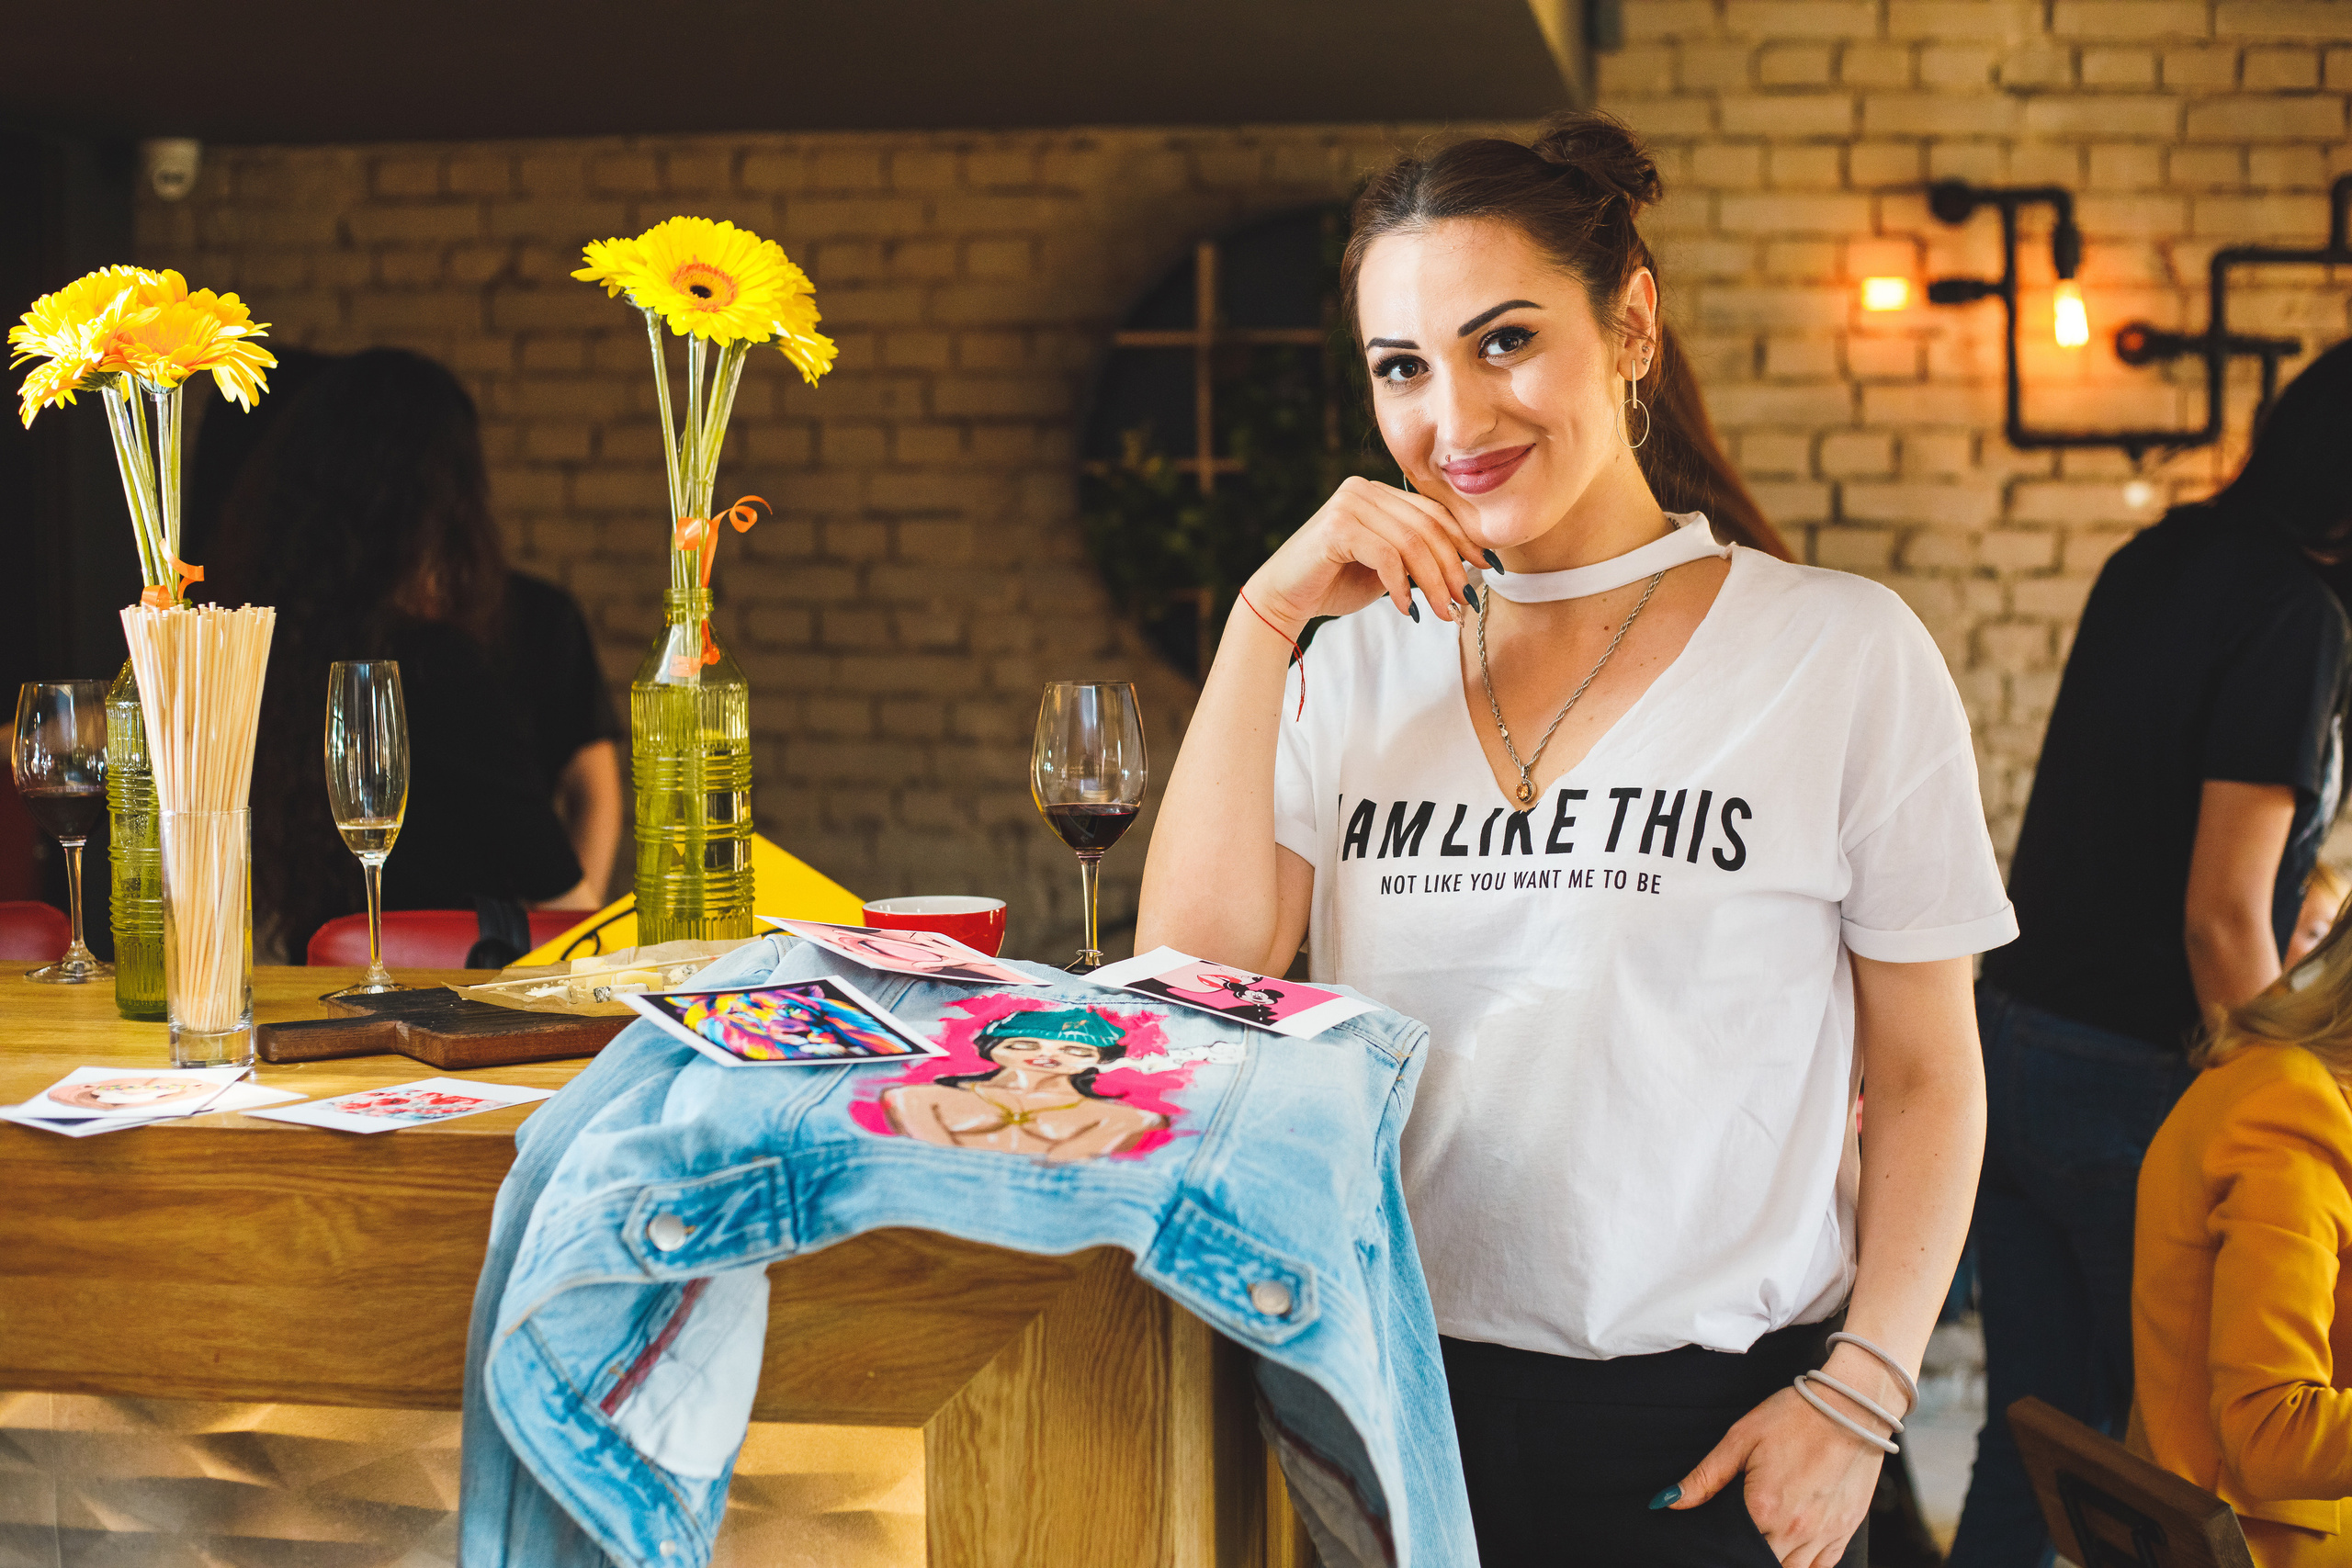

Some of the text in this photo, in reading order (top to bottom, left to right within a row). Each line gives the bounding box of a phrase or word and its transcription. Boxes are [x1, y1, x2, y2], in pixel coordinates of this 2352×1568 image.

[1342, 798, 1437, 862] AM
[1440, 788, 1589, 858] LIKE
[1604, 787, 1753, 872] THIS
[1381, 869, 1662, 895] NOT LIKE YOU WANT ME TO BE
